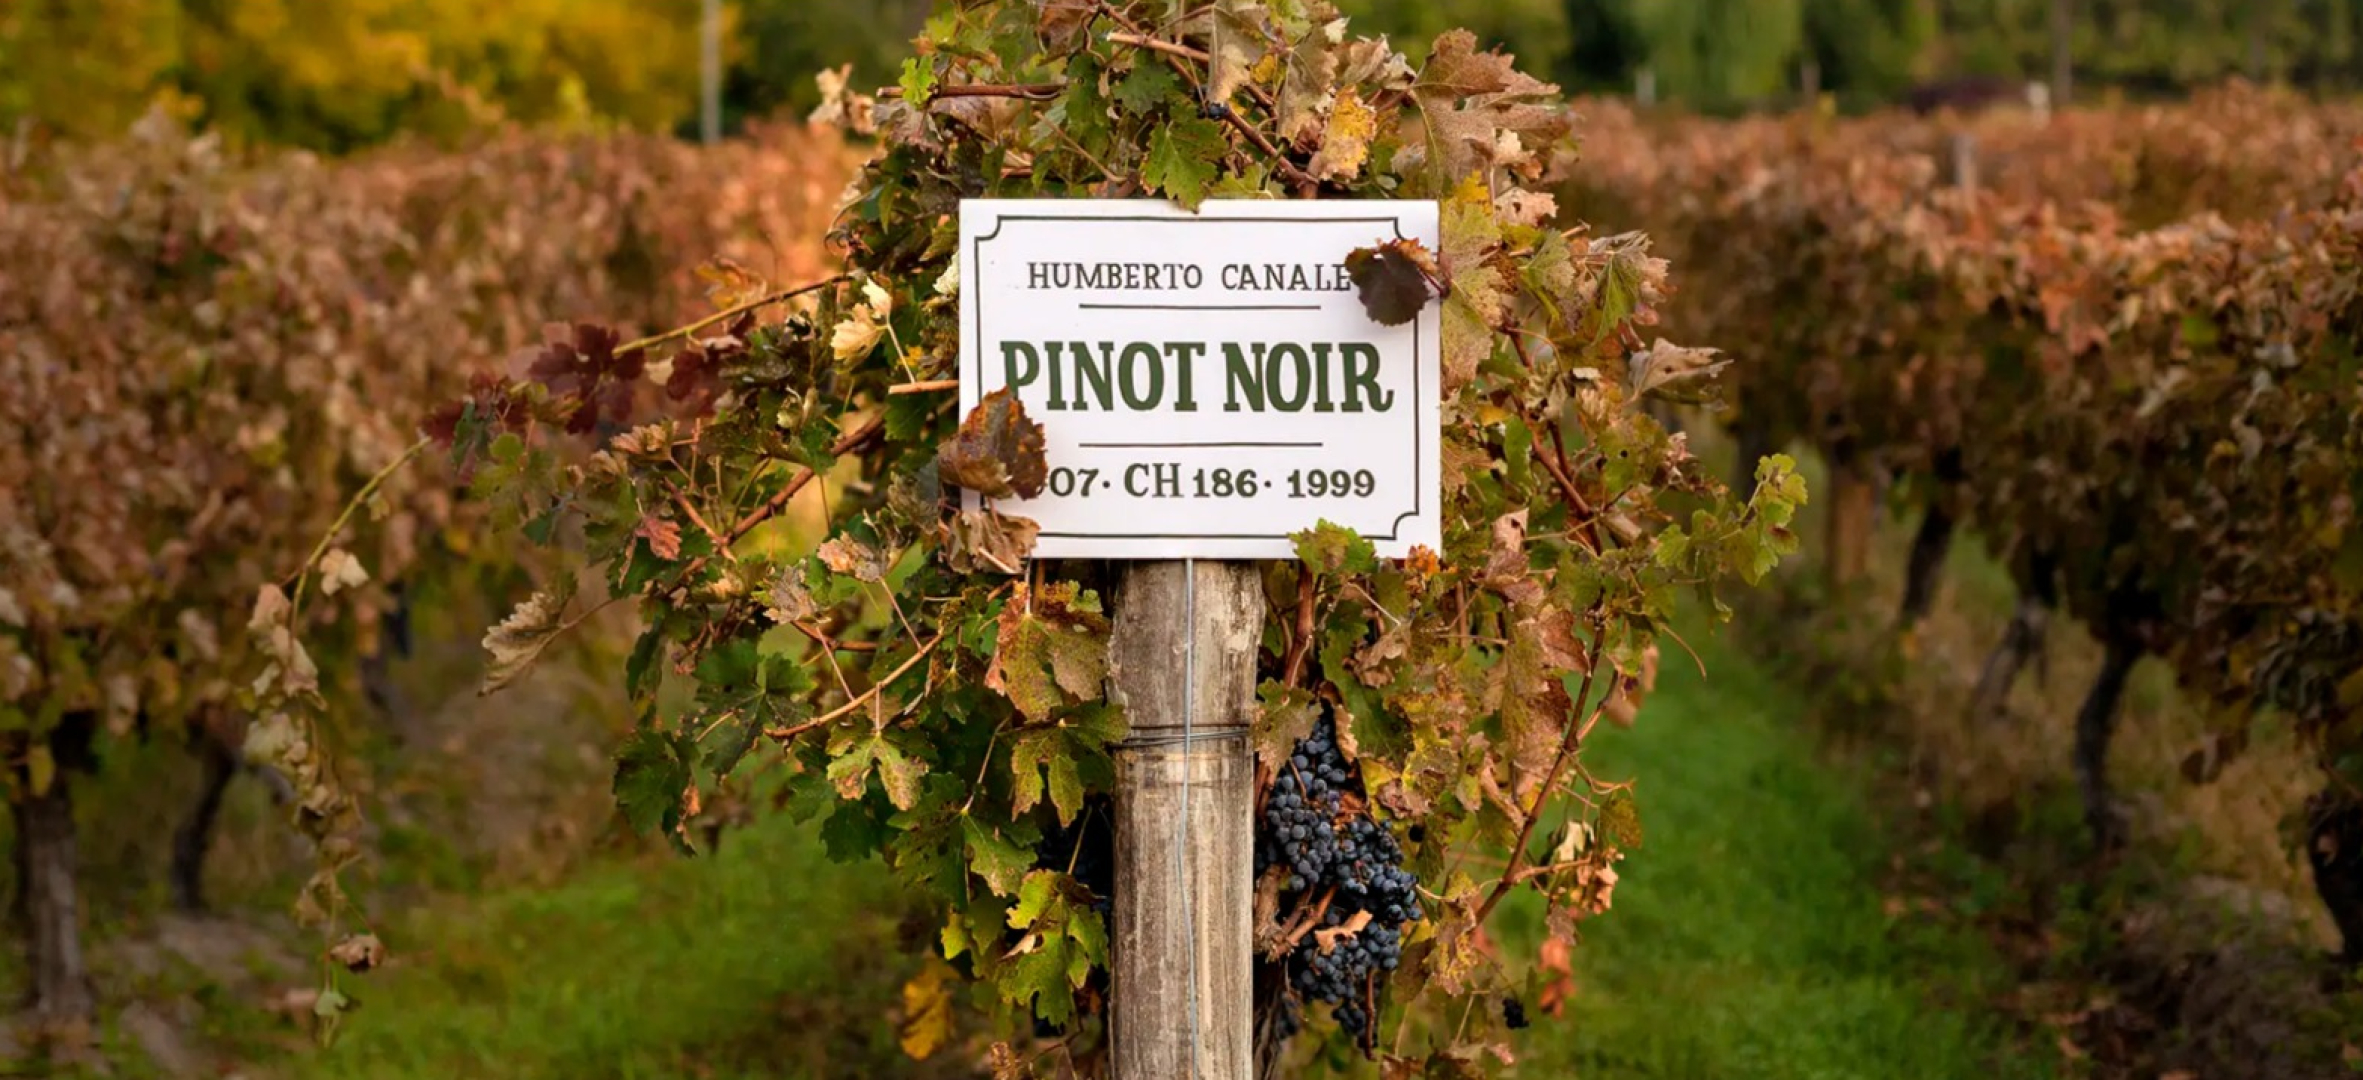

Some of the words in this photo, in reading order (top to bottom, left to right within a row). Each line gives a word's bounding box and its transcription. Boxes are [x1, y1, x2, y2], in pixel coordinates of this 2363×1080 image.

[1027, 262, 1203, 290] HUMBERTO
[1220, 263, 1351, 292] CANALE
[1000, 341, 1206, 412] PINOT
[1221, 342, 1395, 413] NOIR
[1124, 462, 1183, 498] CH
[1287, 468, 1375, 499] 1999
